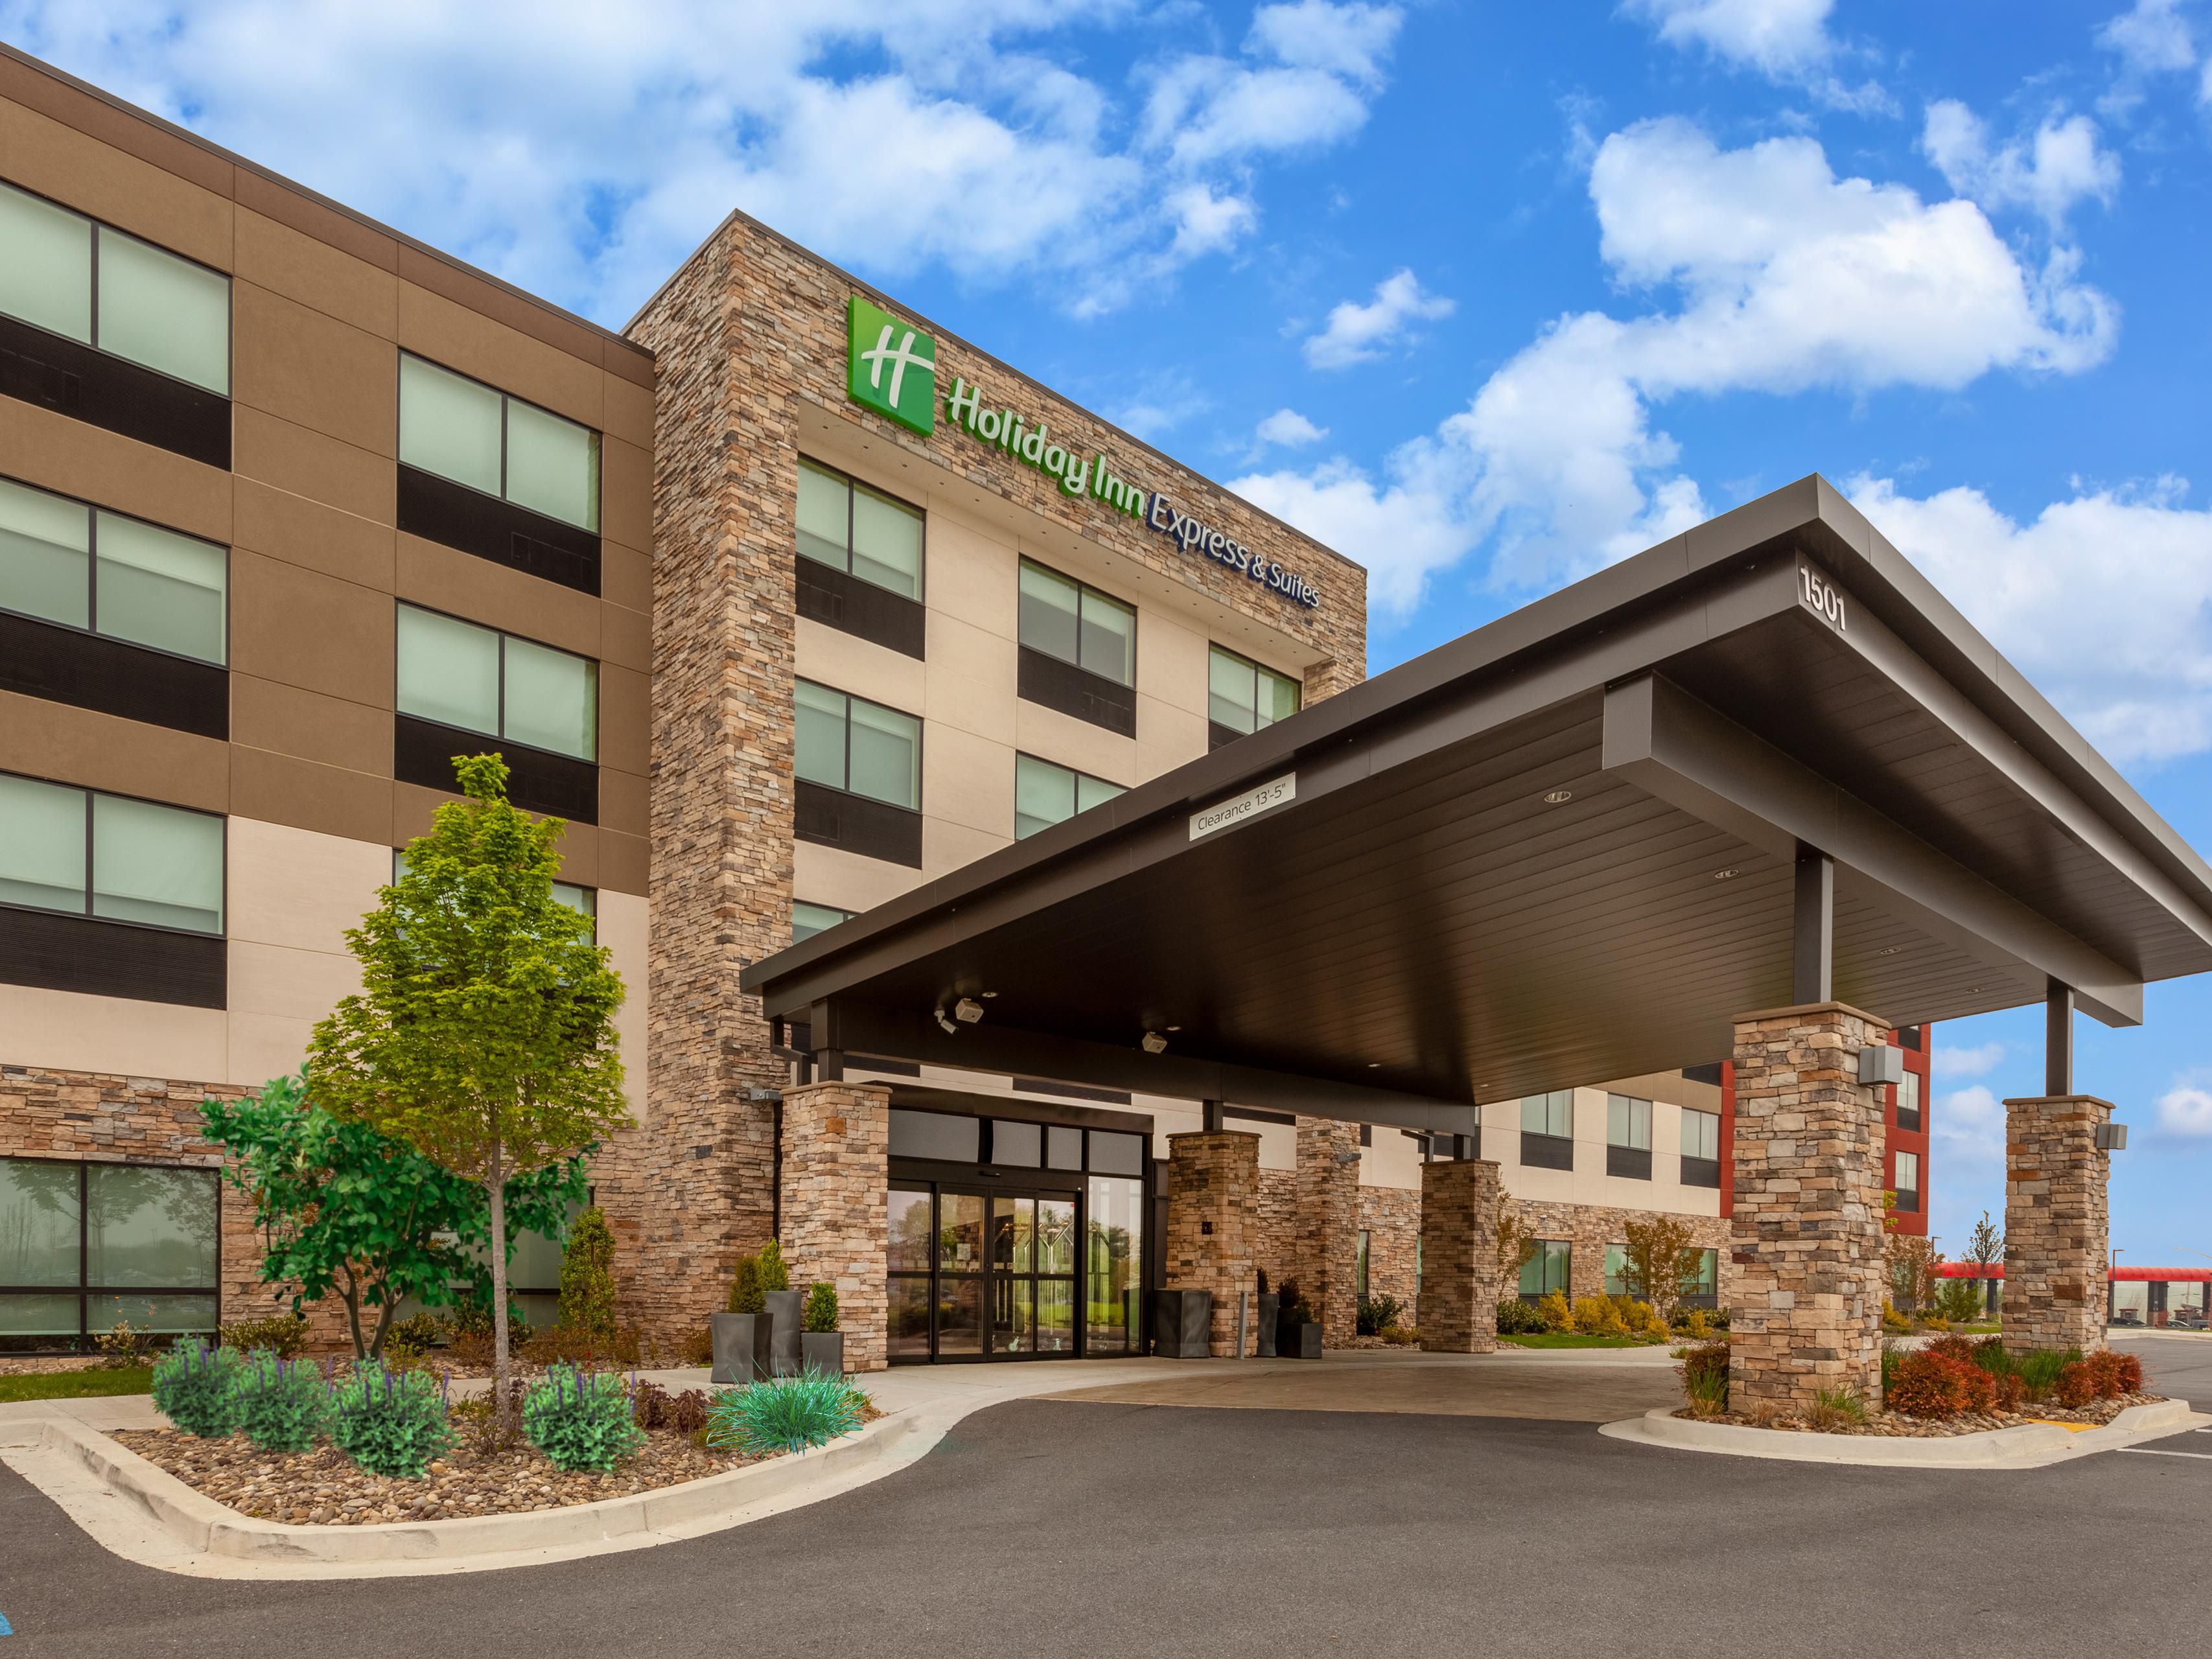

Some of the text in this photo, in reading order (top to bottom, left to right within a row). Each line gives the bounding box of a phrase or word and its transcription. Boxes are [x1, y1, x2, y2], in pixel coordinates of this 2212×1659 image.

[947, 377, 1320, 608] Holiday Inn Express & Suites
[1800, 564, 1846, 631] 1501
[1198, 782, 1286, 830] Clearance 13'-5"
